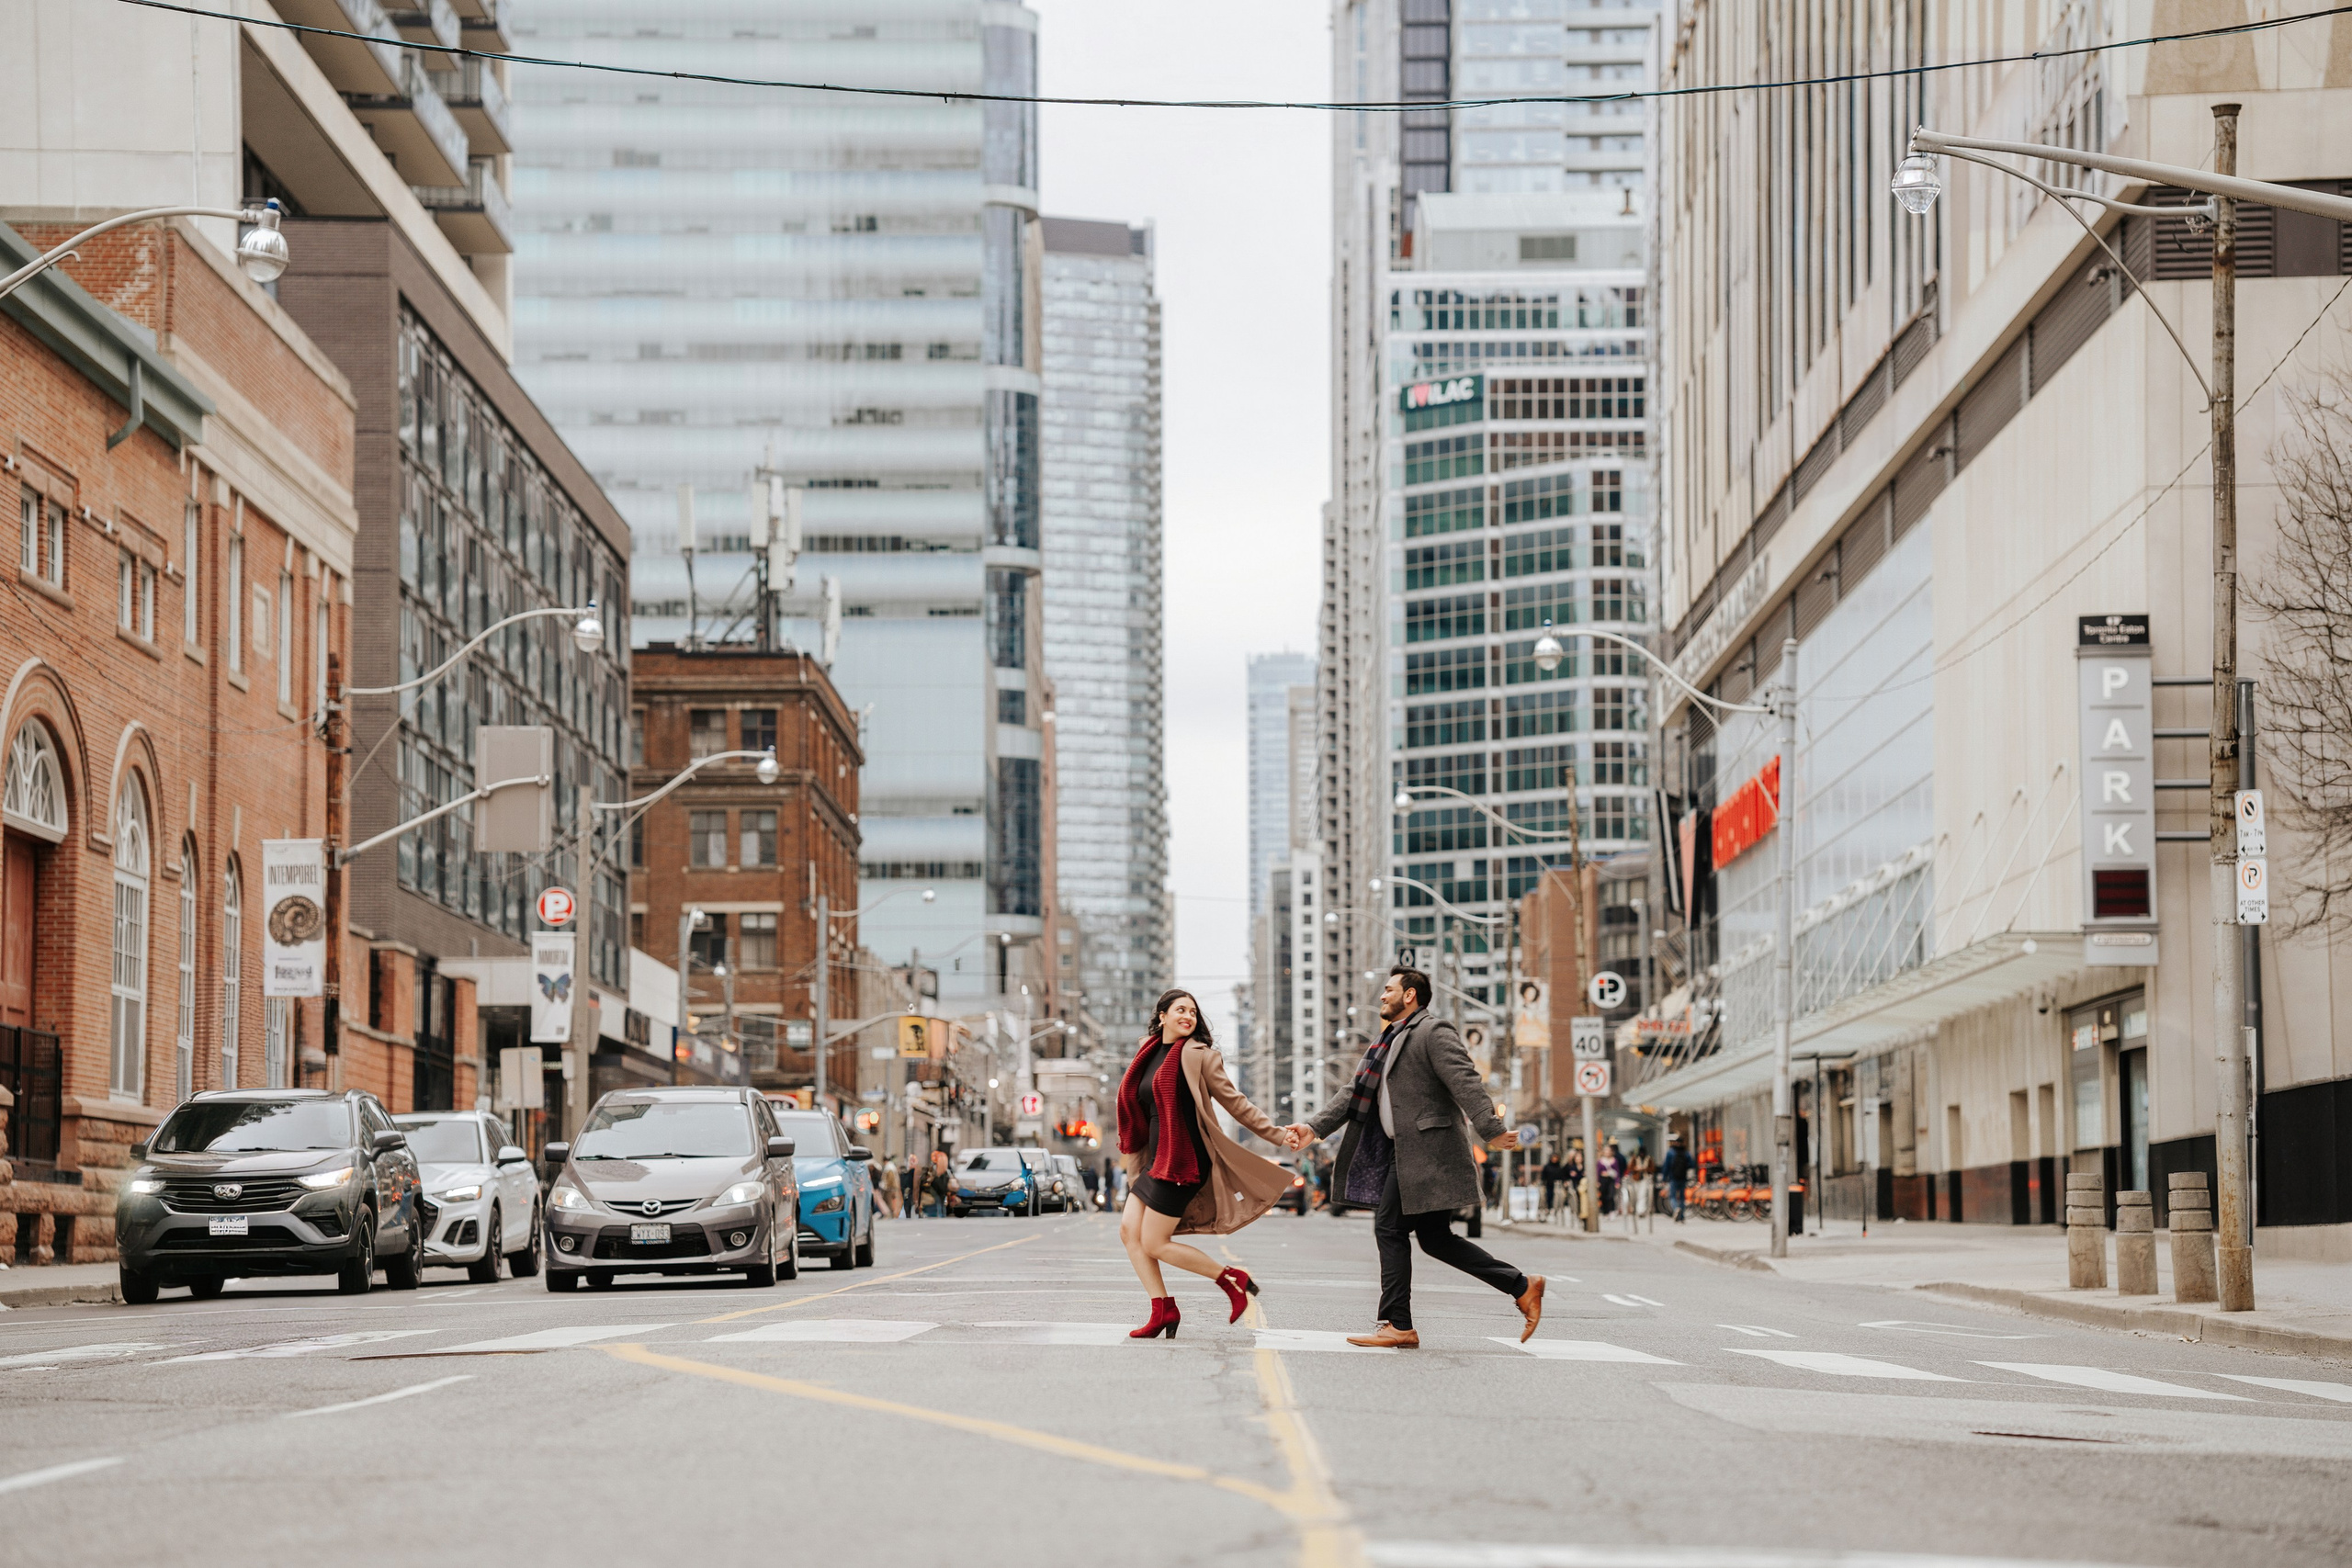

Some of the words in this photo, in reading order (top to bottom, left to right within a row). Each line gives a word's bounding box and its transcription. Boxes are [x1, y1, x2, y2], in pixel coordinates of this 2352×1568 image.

[2084, 625, 2118, 636] Toronto
[2119, 625, 2145, 635] Eaton
[2098, 633, 2130, 645] Centre
[2101, 666, 2134, 855] PARK
[267, 863, 318, 886] INTEMPOREL
[1576, 1035, 1600, 1054] 40
